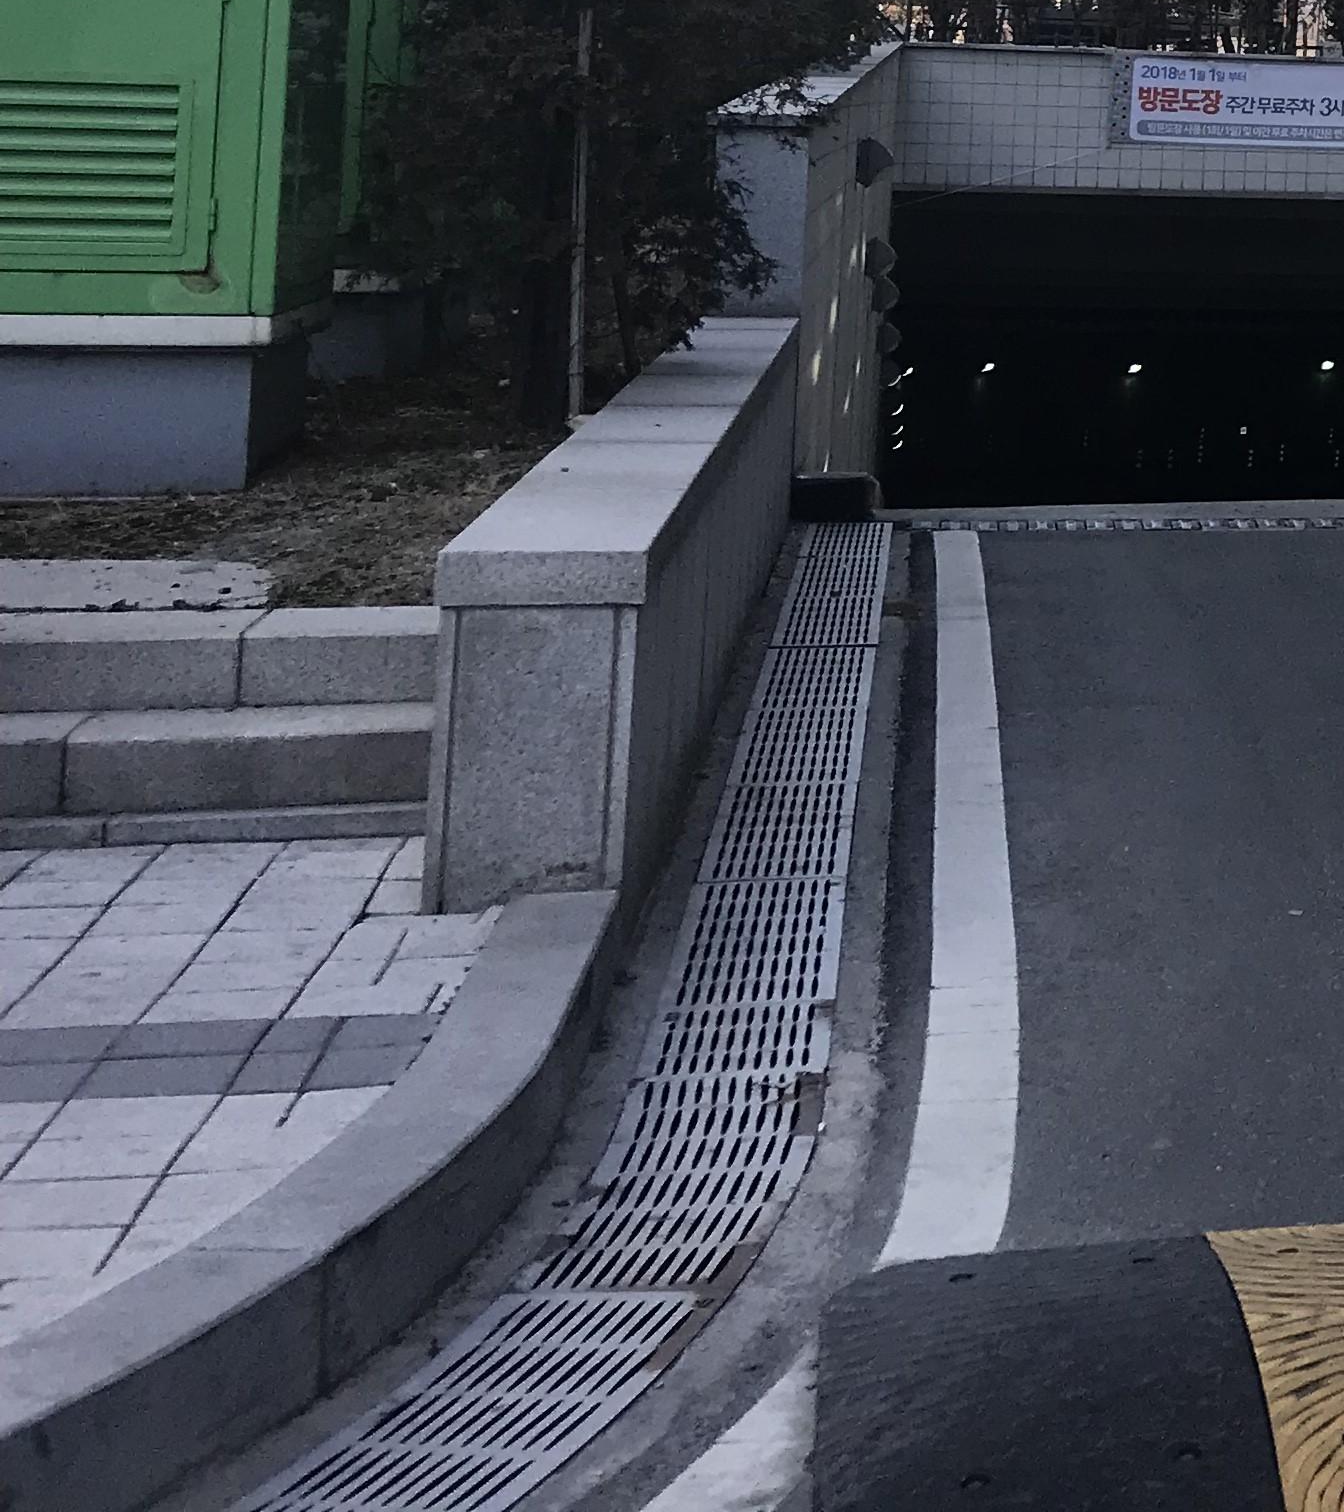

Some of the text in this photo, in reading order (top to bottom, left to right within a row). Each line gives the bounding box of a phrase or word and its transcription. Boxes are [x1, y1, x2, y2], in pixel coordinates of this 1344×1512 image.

[1140, 64, 1247, 84] 2018년 1월 1일 부터
[1137, 86, 1224, 115] 방문도장
[1225, 95, 1256, 115] 주간
